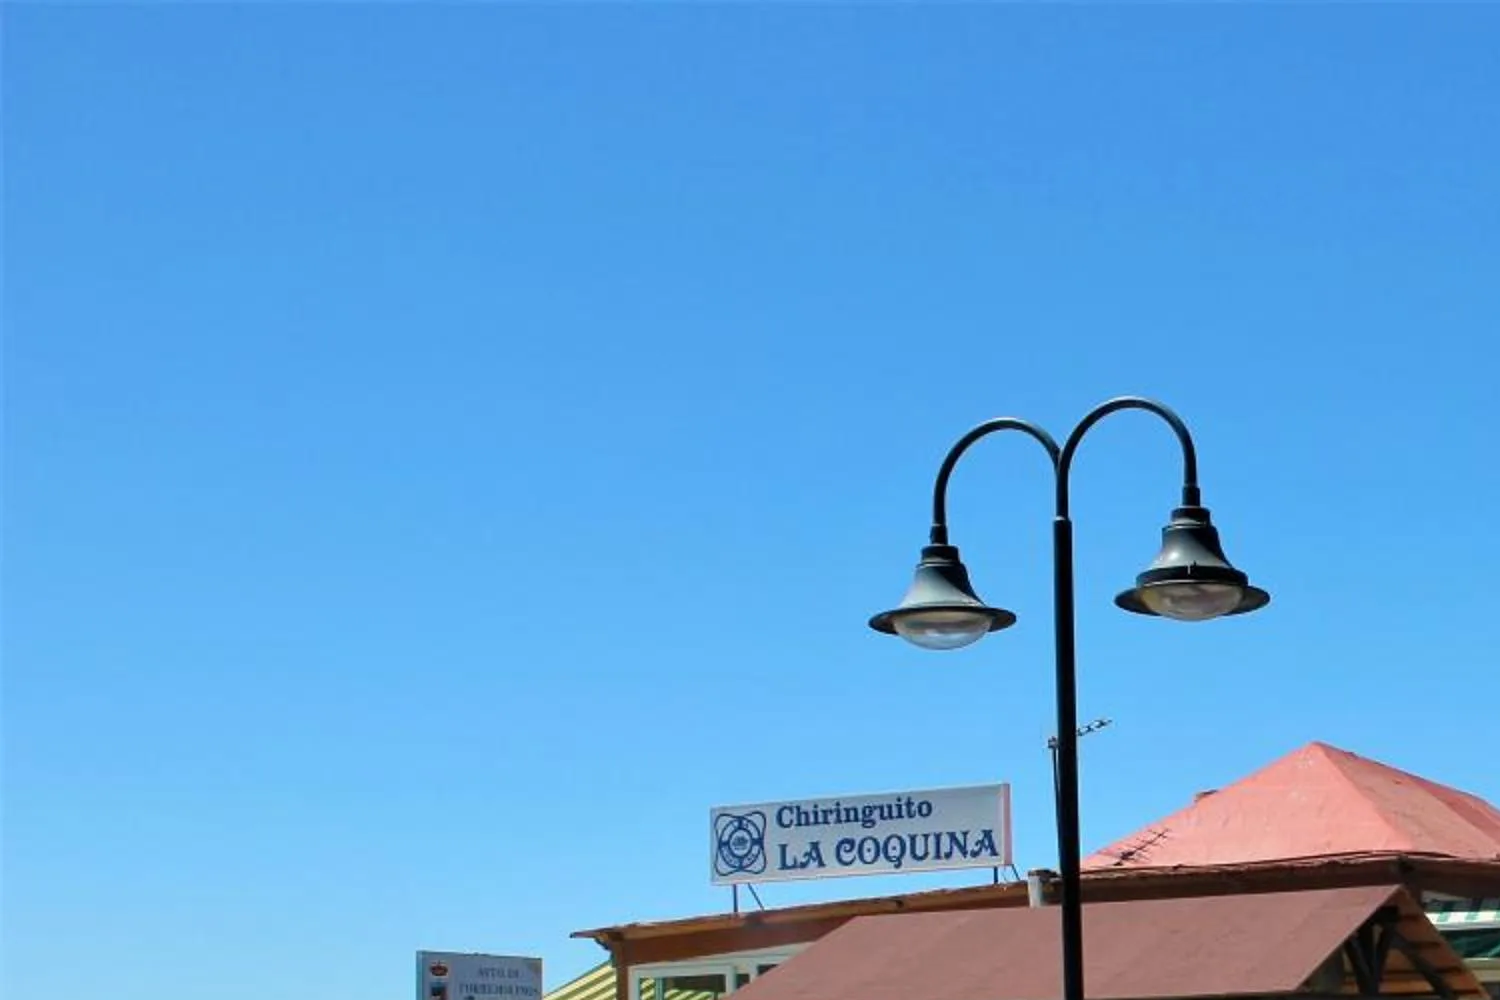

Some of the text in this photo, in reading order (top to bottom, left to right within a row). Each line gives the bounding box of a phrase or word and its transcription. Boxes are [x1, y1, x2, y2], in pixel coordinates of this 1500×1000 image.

[776, 797, 933, 829] Chiringuito
[777, 828, 1000, 871] LA COQUINA
